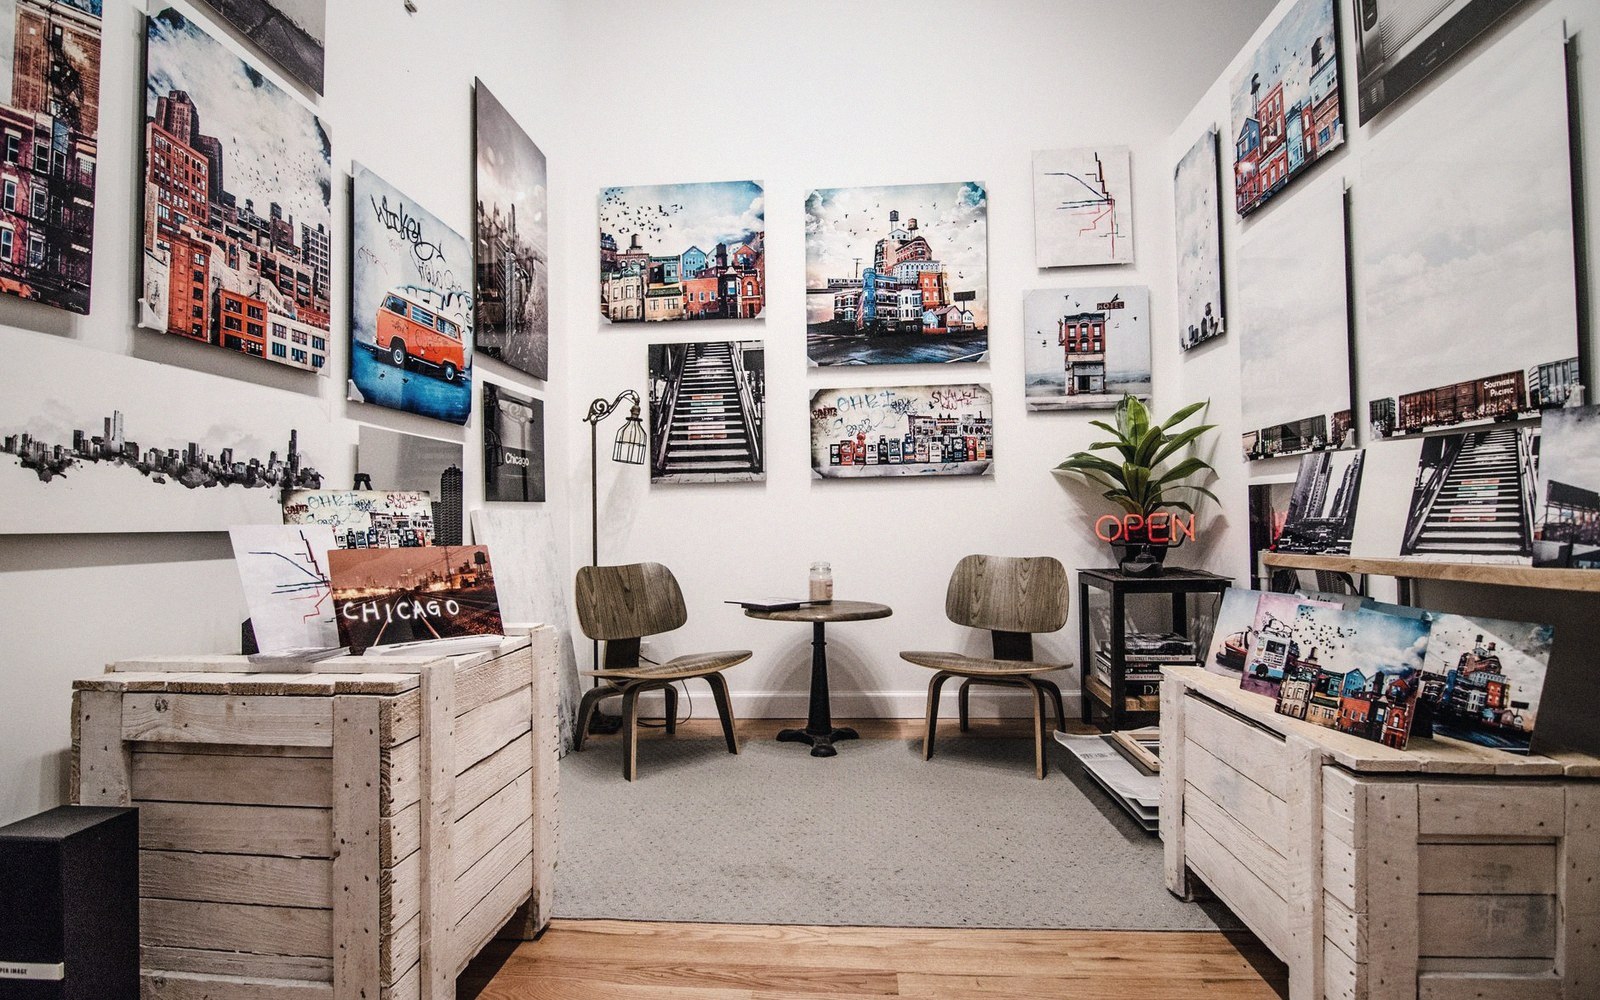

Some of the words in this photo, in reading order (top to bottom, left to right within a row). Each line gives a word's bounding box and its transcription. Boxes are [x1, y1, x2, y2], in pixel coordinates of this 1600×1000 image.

[505, 452, 530, 468] Chicago
[1095, 513, 1195, 542] OPEN
[343, 599, 460, 623] CHICAGO
